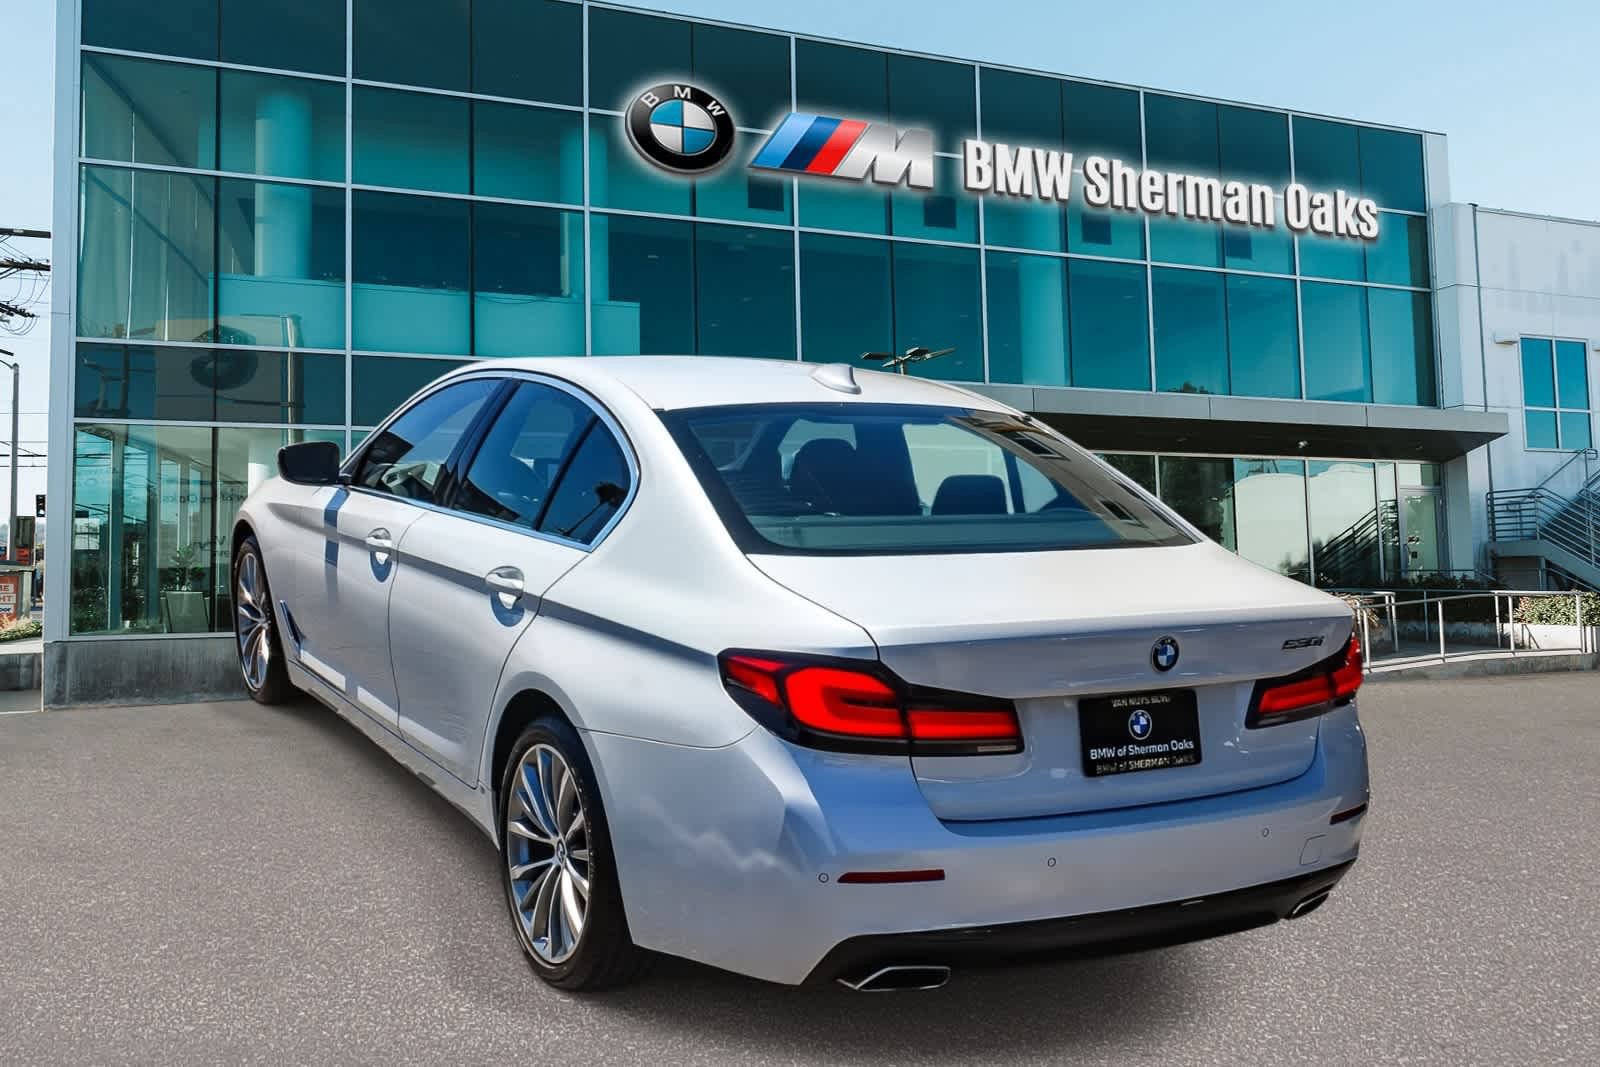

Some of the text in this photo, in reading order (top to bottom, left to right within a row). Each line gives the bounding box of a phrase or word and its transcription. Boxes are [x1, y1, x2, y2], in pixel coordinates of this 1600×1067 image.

[641, 84, 726, 118] BMW
[963, 138, 1380, 240] BMW Sherman Oaks
[1090, 739, 1195, 760] BMW of Sherman Oaks
